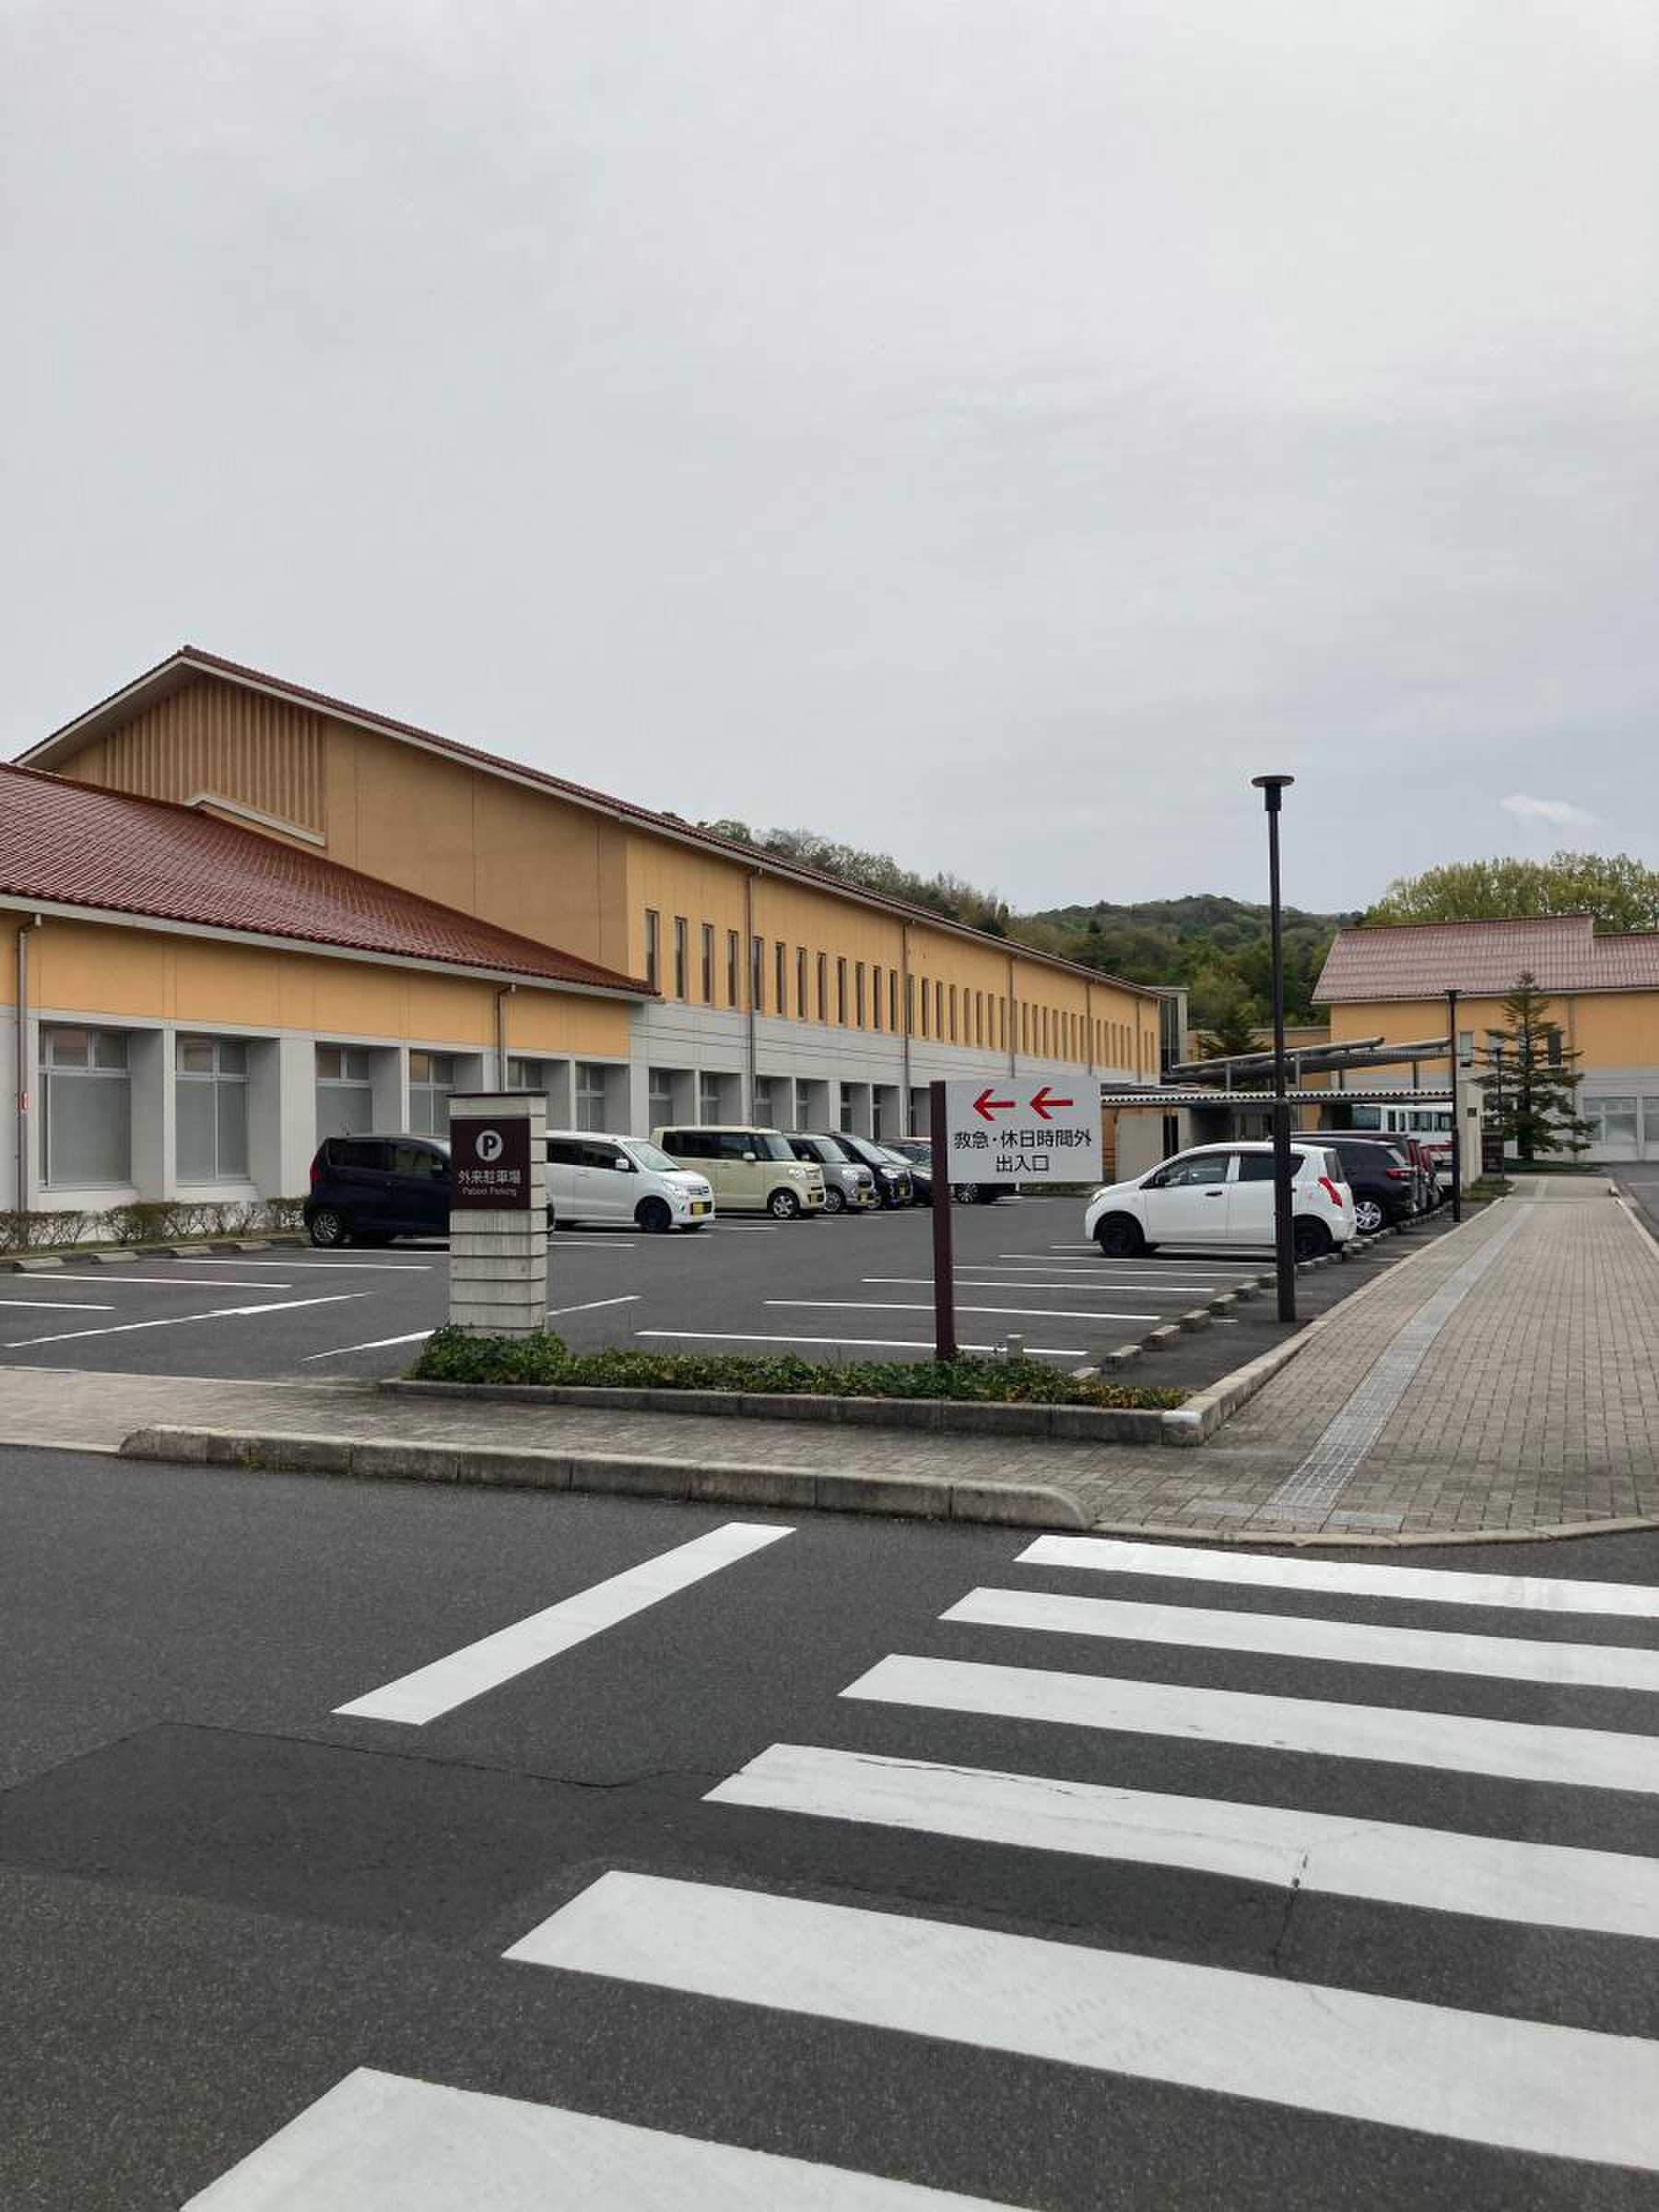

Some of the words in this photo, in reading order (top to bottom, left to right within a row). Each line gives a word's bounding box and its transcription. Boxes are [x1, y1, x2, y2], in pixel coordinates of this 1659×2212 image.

[482, 1135, 498, 1157] P
[954, 1129, 1092, 1149] 救急・休日時間外
[995, 1155, 1049, 1173] 出入口
[458, 1169, 521, 1184] 外来駐車場
[489, 1187, 517, 1197] Parking
